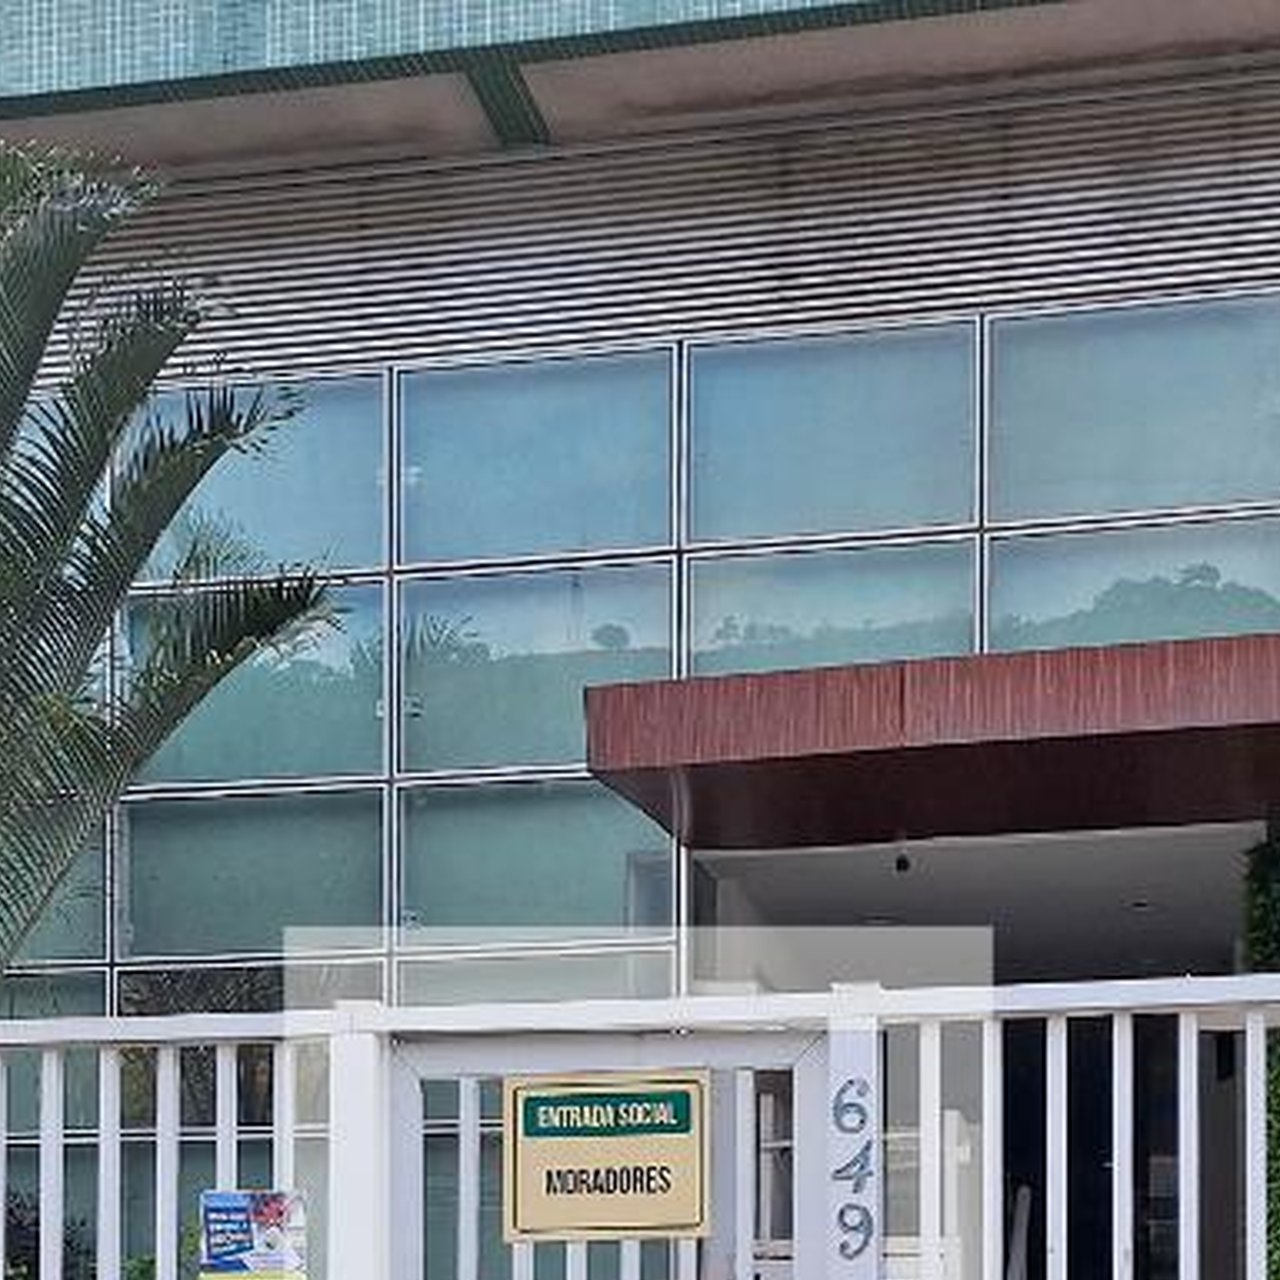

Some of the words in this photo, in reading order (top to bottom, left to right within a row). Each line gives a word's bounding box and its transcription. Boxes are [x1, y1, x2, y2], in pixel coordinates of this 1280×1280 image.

[536, 1105, 615, 1129] ENTRADA
[617, 1102, 678, 1126] SOCIAL
[544, 1165, 672, 1196] MORADORES
[832, 1078, 874, 1261] 649
